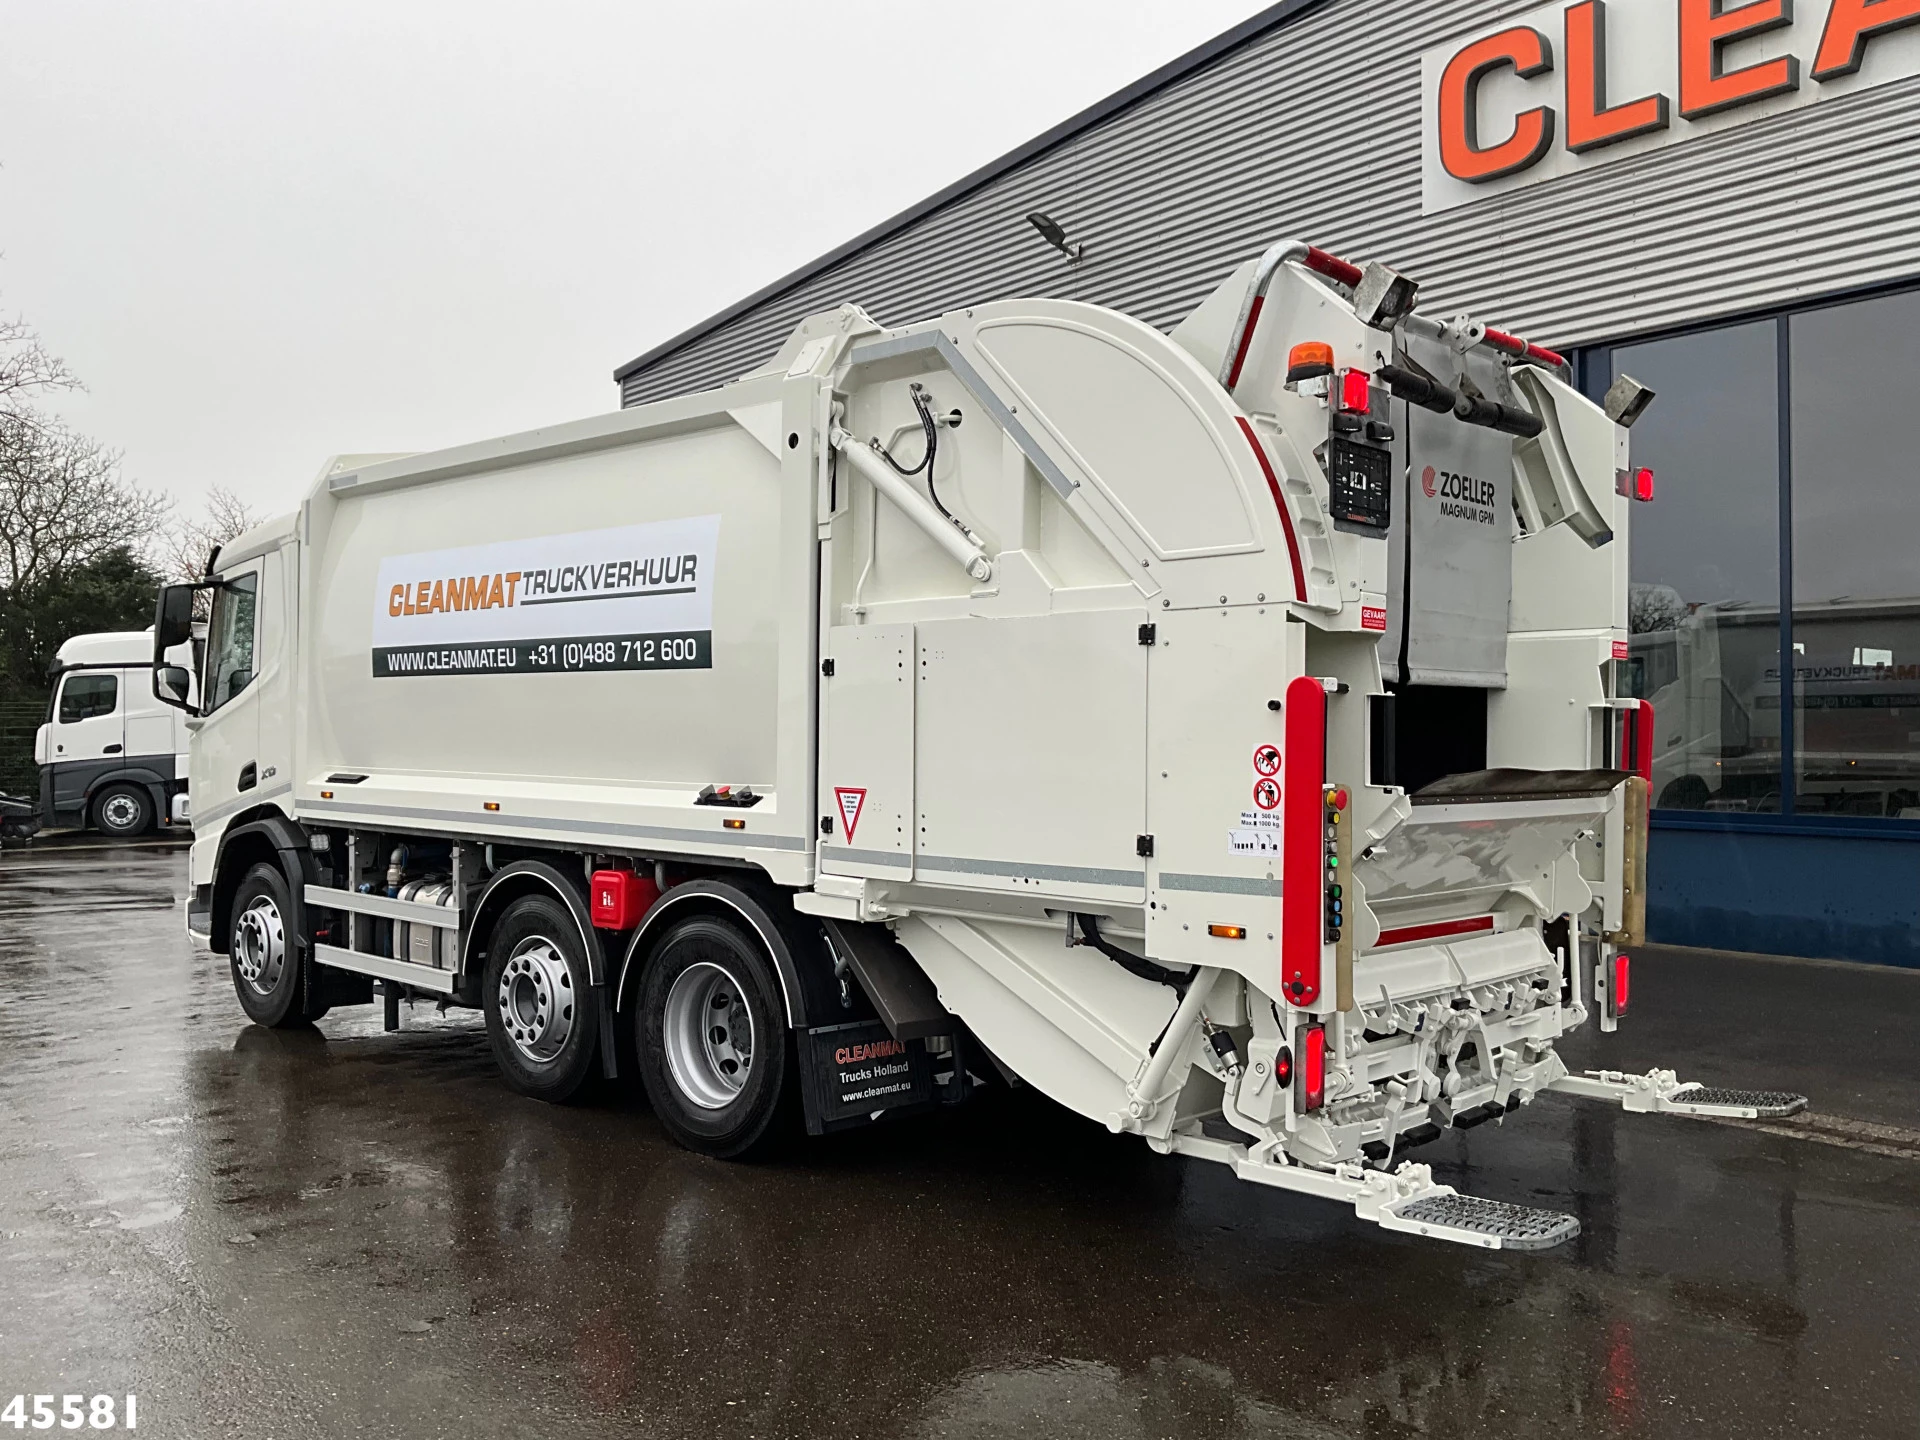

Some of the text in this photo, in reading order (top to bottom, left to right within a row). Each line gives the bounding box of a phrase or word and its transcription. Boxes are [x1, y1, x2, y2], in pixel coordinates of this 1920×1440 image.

[1440, 471, 1495, 508] ZOELLER
[1440, 501, 1495, 526] MAGNUM GPM
[389, 554, 698, 617] CLEANMAT TRUCKVERHUUR
[387, 638, 697, 671] WWW.CLEANMAT.EU +31 (0)488 712 600
[839, 1061, 909, 1084] Trucks Holland
[842, 1082, 911, 1102] www.cleanmat.eu
